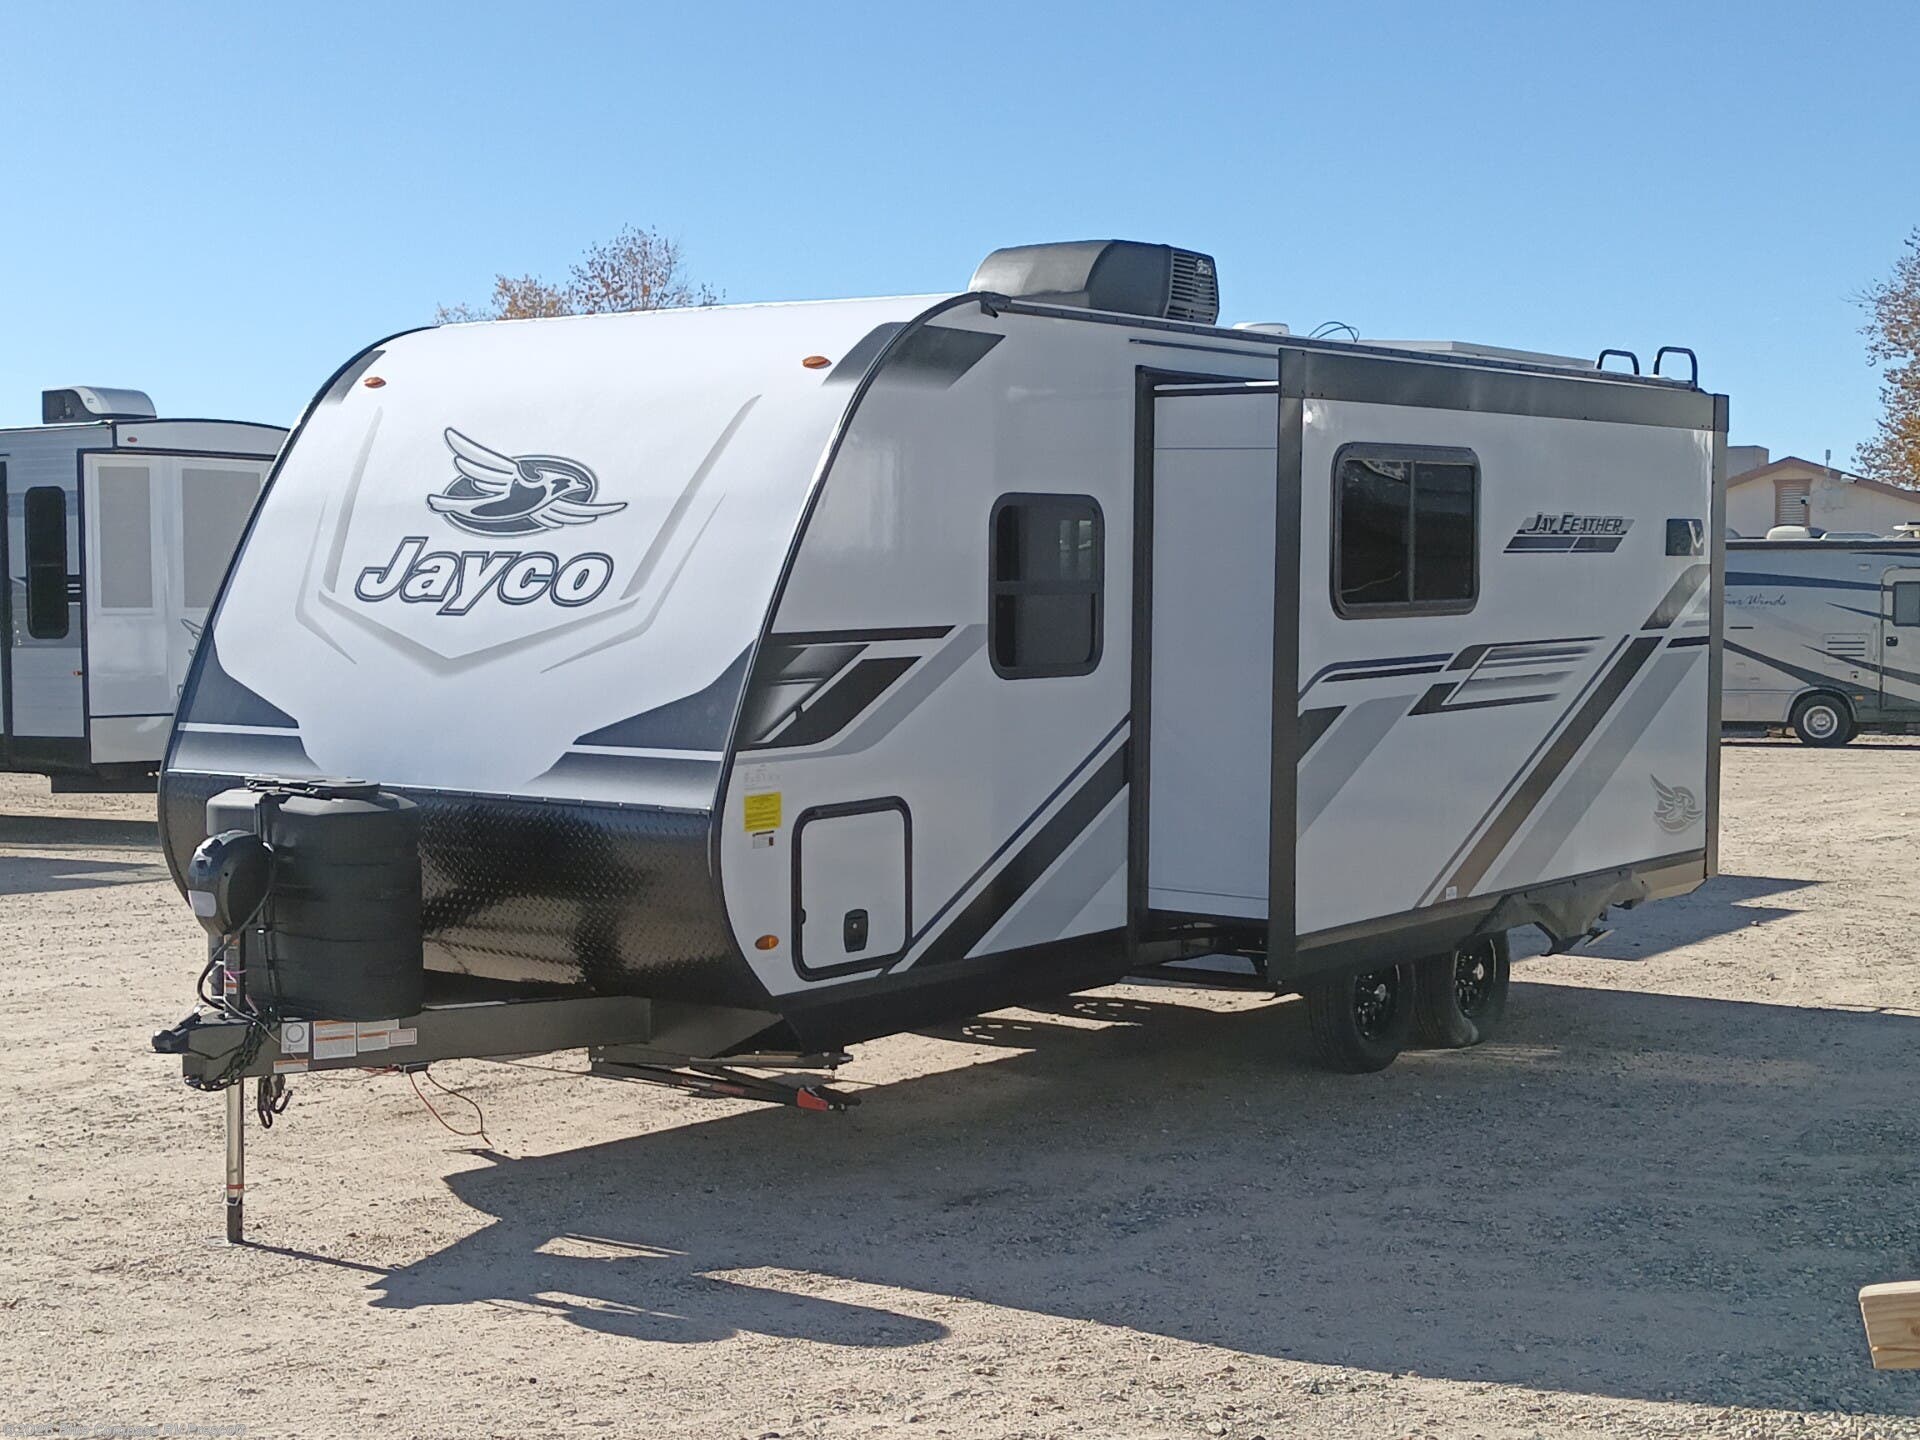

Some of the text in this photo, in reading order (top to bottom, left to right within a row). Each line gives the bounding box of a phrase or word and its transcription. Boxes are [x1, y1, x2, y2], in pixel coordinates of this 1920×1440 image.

[1526, 513, 1623, 533] JAY FEATHER
[355, 536, 615, 616] Jayco
